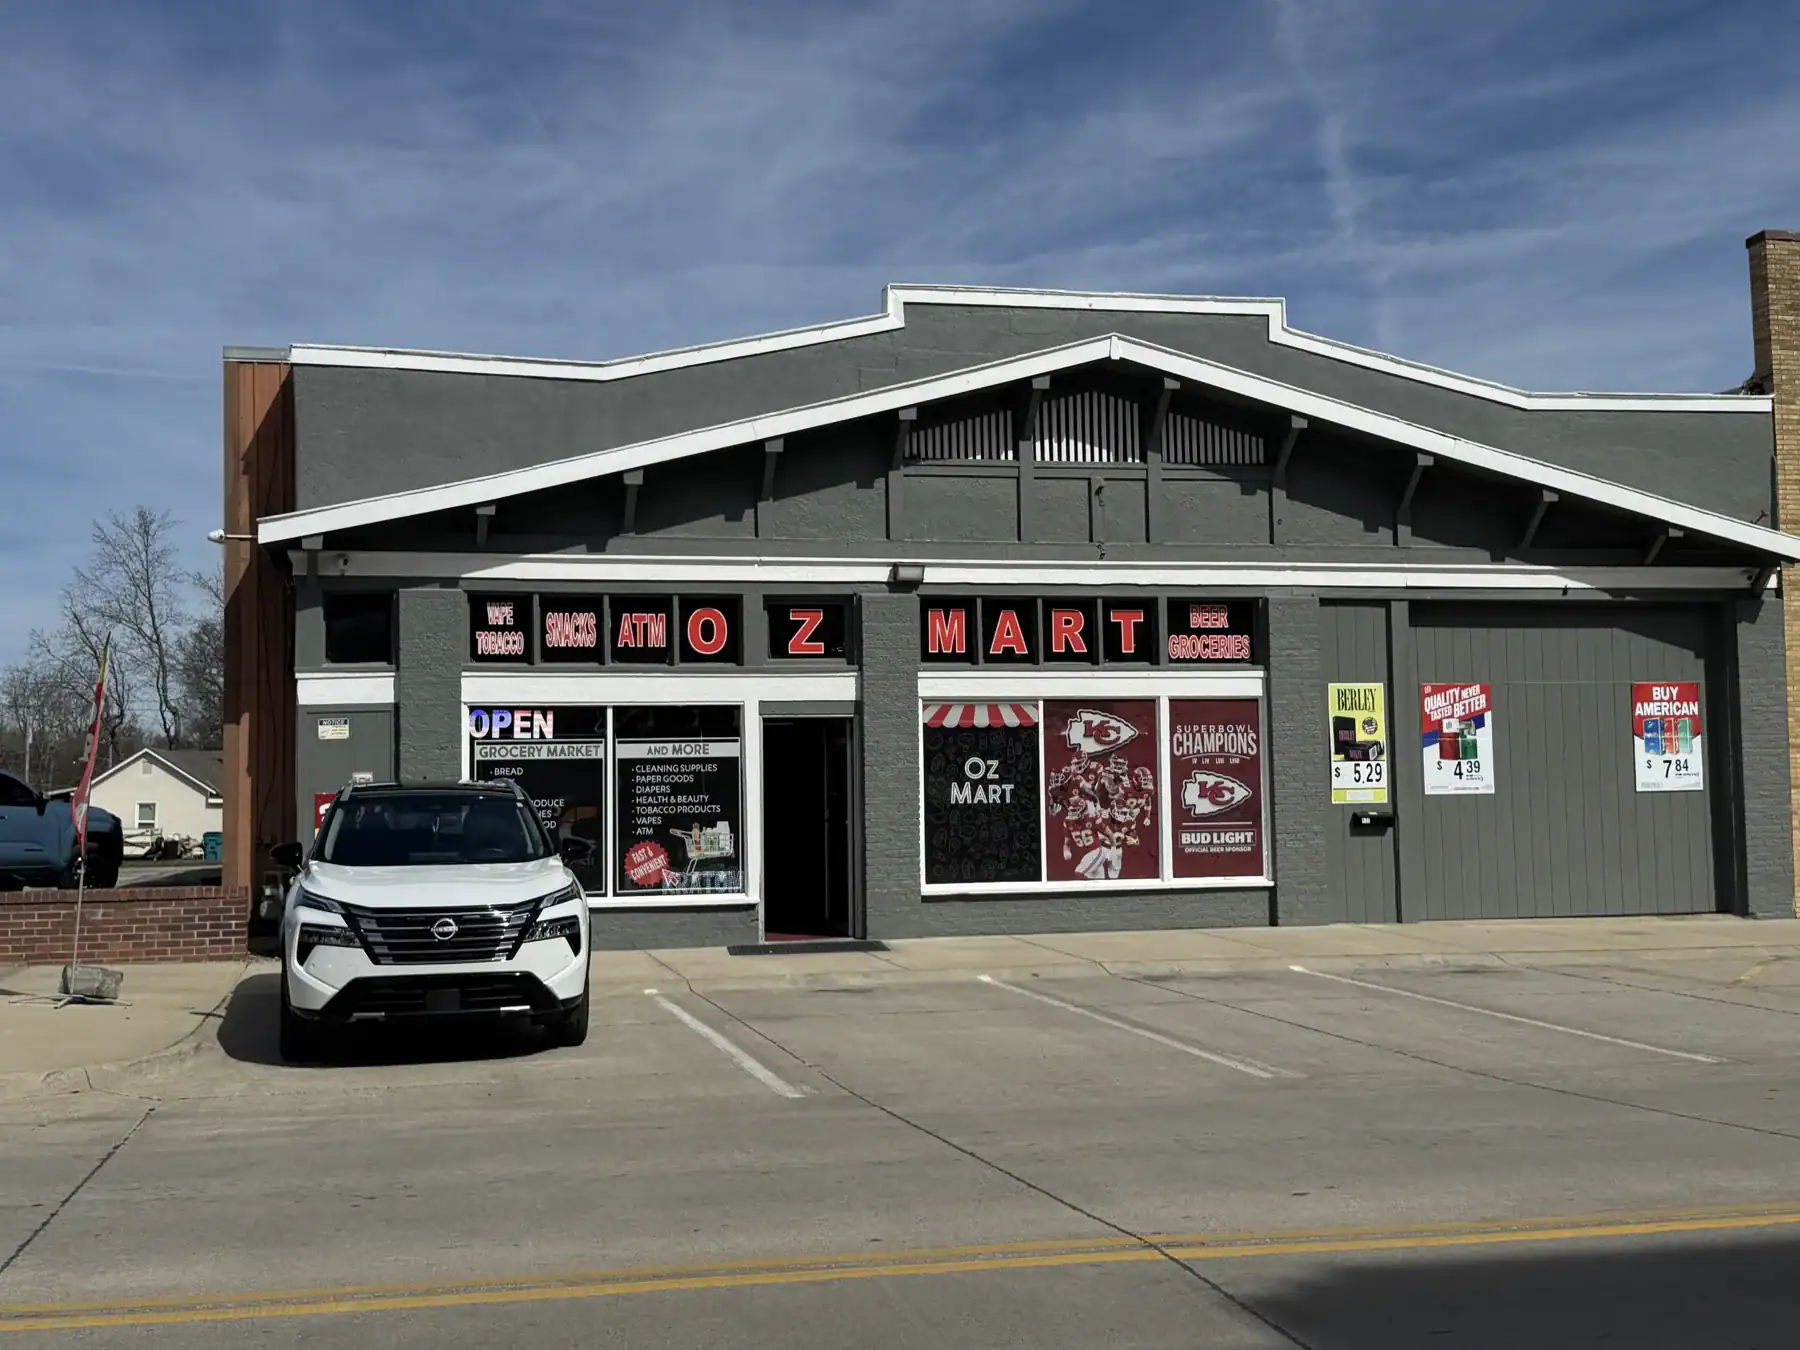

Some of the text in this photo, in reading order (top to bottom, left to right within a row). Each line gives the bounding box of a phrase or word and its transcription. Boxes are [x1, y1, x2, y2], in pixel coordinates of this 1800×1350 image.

[487, 602, 514, 625] VAPE
[1190, 604, 1229, 628] BEER
[545, 612, 597, 648] SNACKS
[617, 613, 667, 648] ATM
[475, 631, 525, 655] TOBACCO
[1168, 634, 1251, 660] GROCERIES
[1336, 688, 1377, 712] BERLEY
[1424, 684, 1480, 715] QUALITY NEVER
[1652, 686, 1679, 700] BUY
[1431, 693, 1486, 721] TASTED BETTER
[1635, 701, 1699, 716] AMERICAN
[469, 709, 554, 739] OPEN
[479, 744, 601, 758] GROCERY MARKET
[646, 743, 710, 756] AND MORE
[1173, 733, 1257, 756] CHAMPIONS
[494, 767, 524, 776] BREAD
[635, 763, 718, 773] CLEANING SUPPLIES
[1436, 760, 1443, 771] $
[1646, 759, 1652, 769] $
[635, 774, 694, 783] PAPER GOODS
[1333, 763, 1383, 784] $ 5.29
[635, 785, 671, 794] DIAPERS
[635, 794, 709, 804] HEALTH & BEAUTY
[636, 804, 721, 815] TOBACCO PRODUCTS
[636, 816, 662, 825] VAPES
[636, 827, 654, 836] ATM
[1071, 829, 1094, 847] 56
[1181, 832, 1254, 844] BUD LIGHT
[631, 847, 647, 865] FAST
[1184, 846, 1209, 854] OFFICIAL
[630, 854, 668, 881] CONVENIENT
